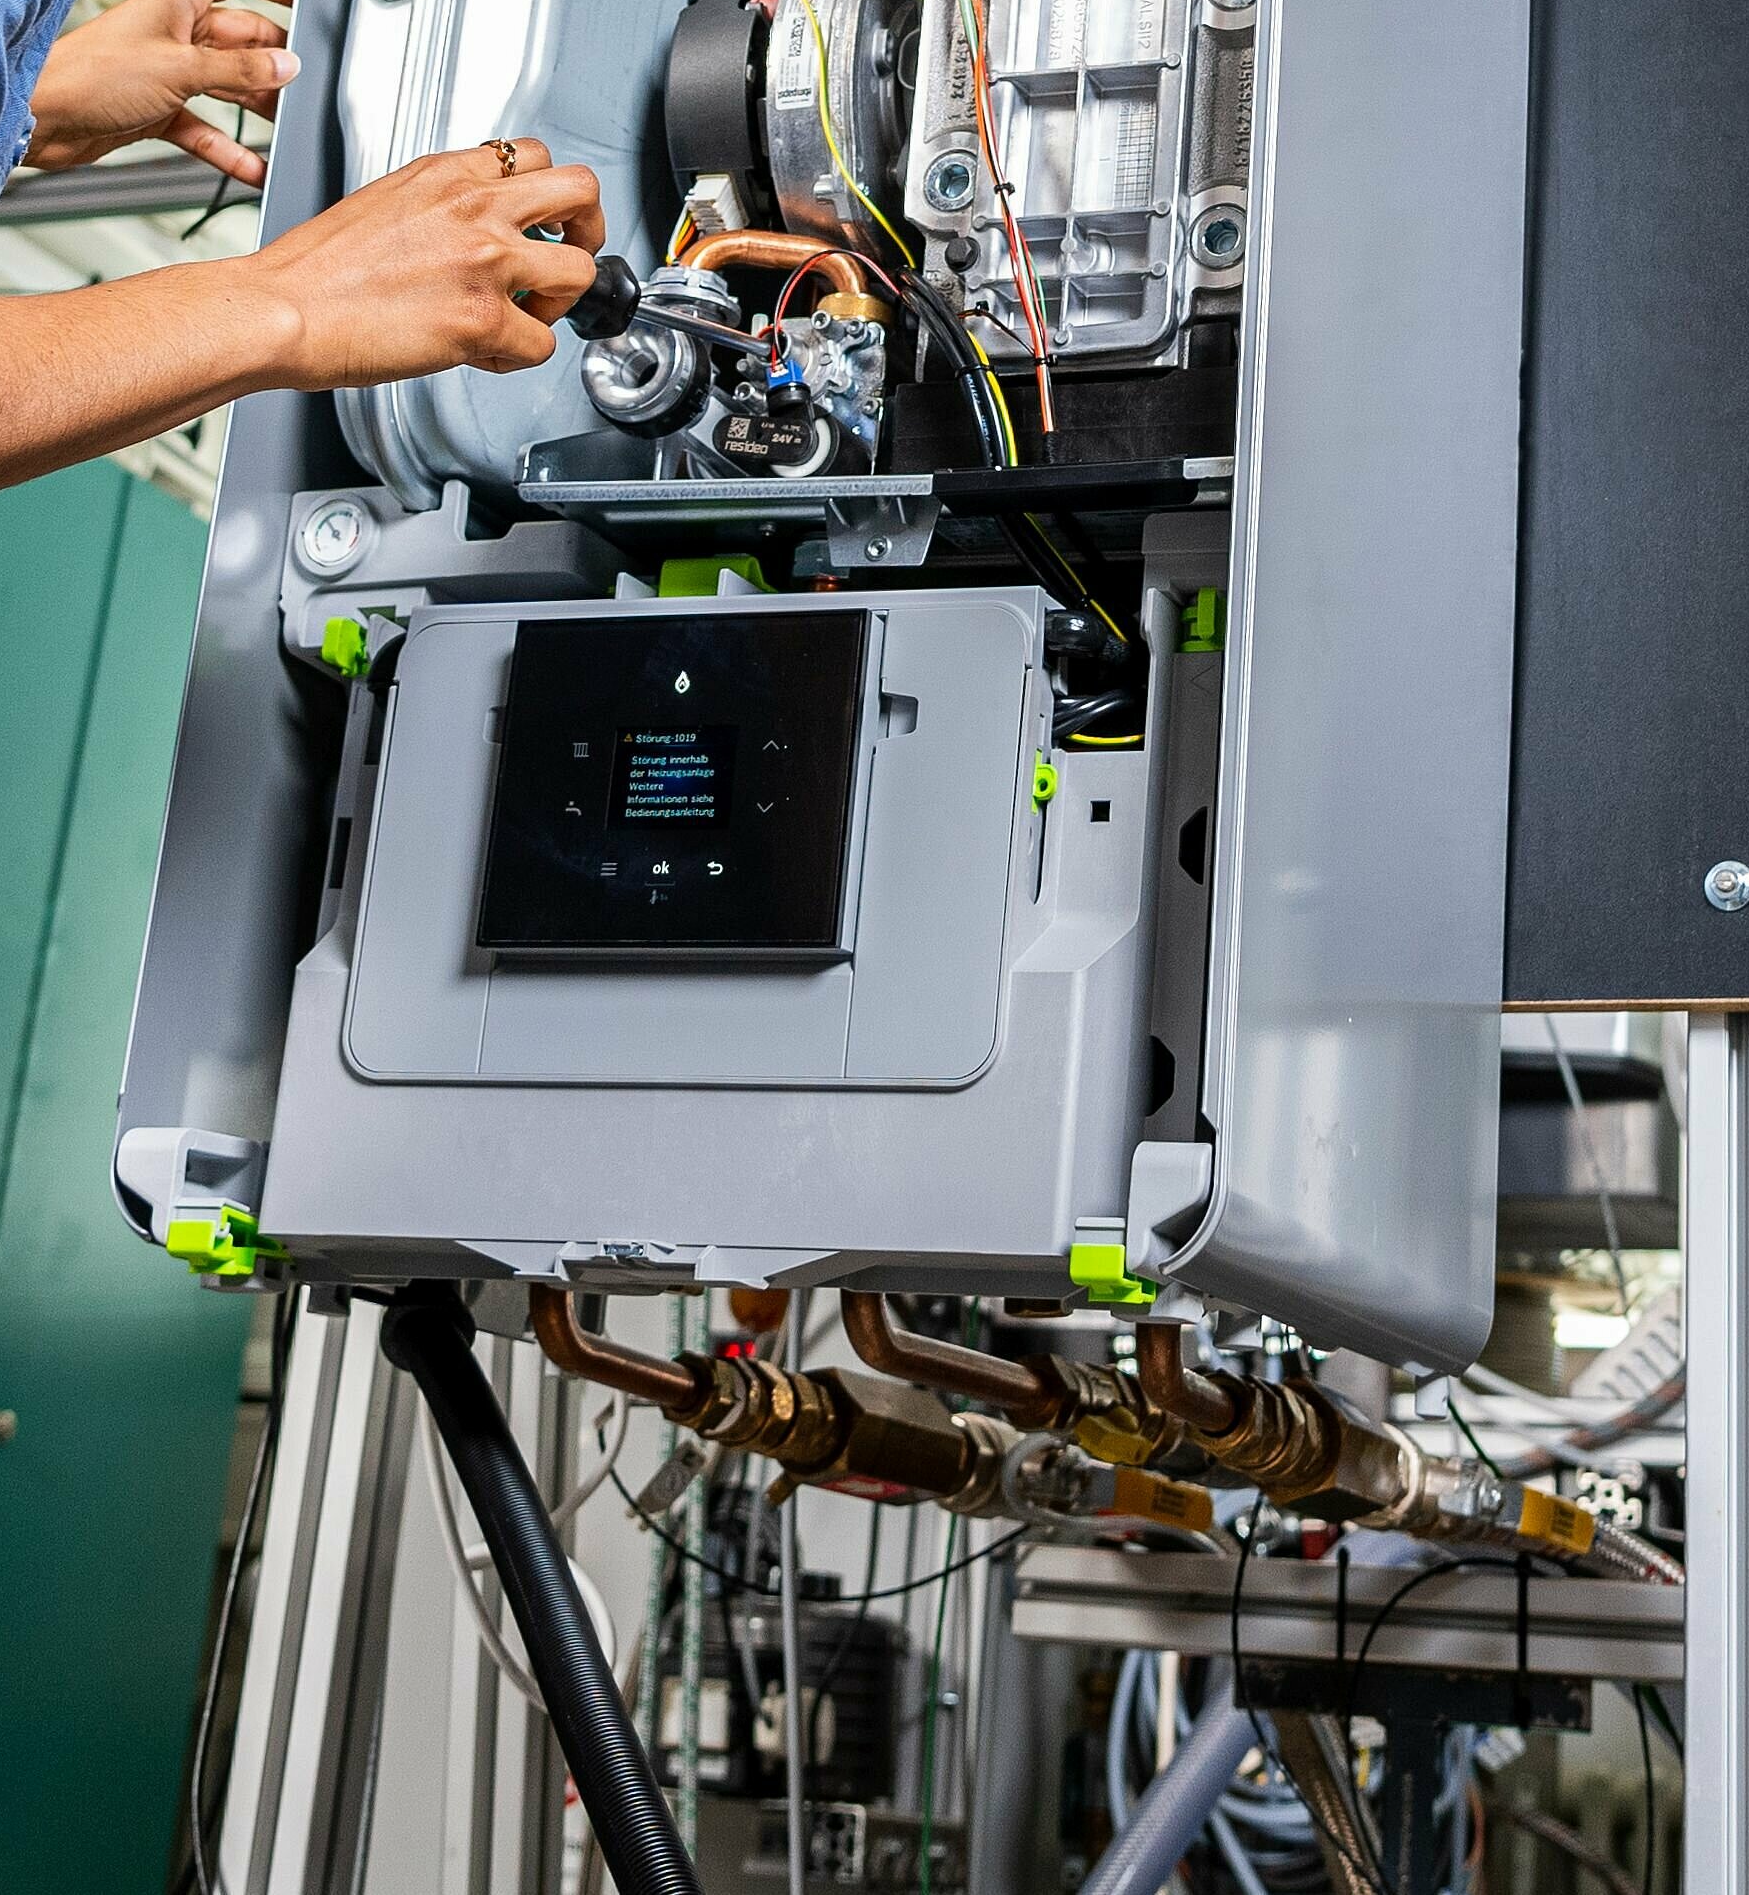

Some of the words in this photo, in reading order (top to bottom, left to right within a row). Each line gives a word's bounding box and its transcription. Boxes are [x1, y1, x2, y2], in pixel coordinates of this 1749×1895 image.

[771, 432, 793, 444] 24V
[724, 440, 769, 455] resideo
[669, 754, 709, 765] innerhalb
[629, 768, 646, 778] der
[629, 782, 664, 792] Weitere
[626, 794, 688, 805] Informationen
[690, 794, 715, 804] siehe
[625, 807, 715, 819] Bedienungsanleitung
[652, 860, 670, 875] ok
